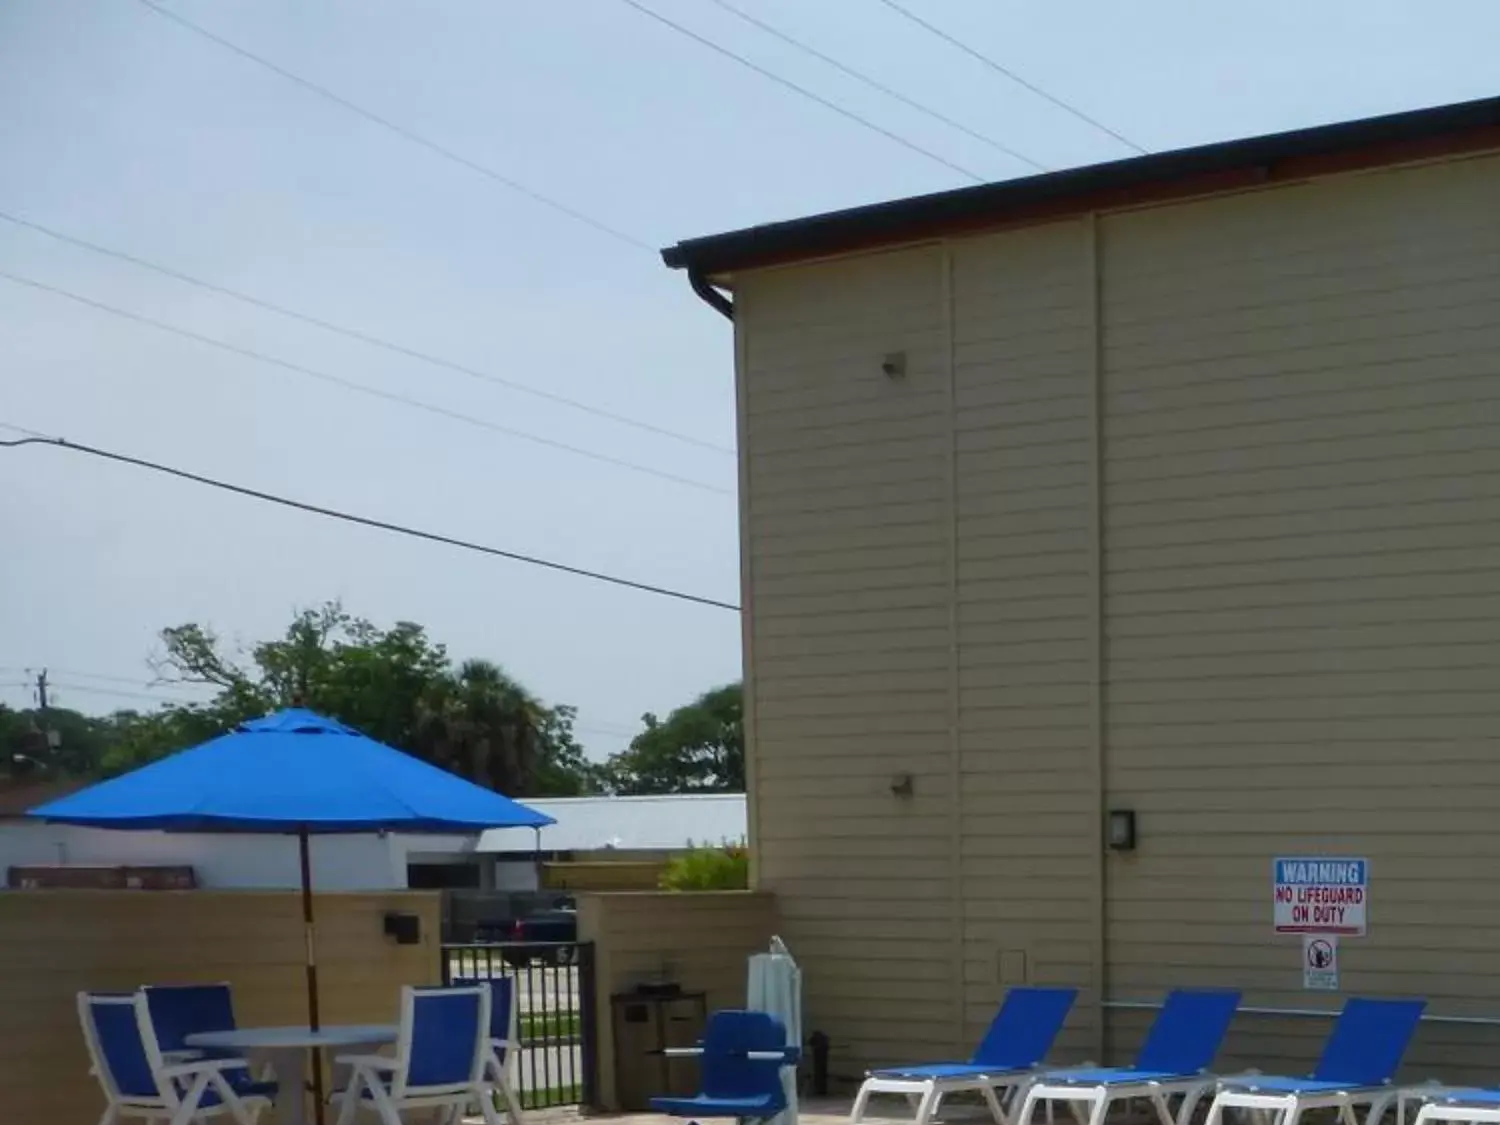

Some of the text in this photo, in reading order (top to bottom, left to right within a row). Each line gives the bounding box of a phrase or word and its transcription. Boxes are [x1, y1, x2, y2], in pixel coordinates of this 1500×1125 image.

[1283, 863, 1359, 883] WARNING
[1275, 886, 1363, 904] NO LIFEGUARD
[1292, 905, 1345, 924] ON DUTY
